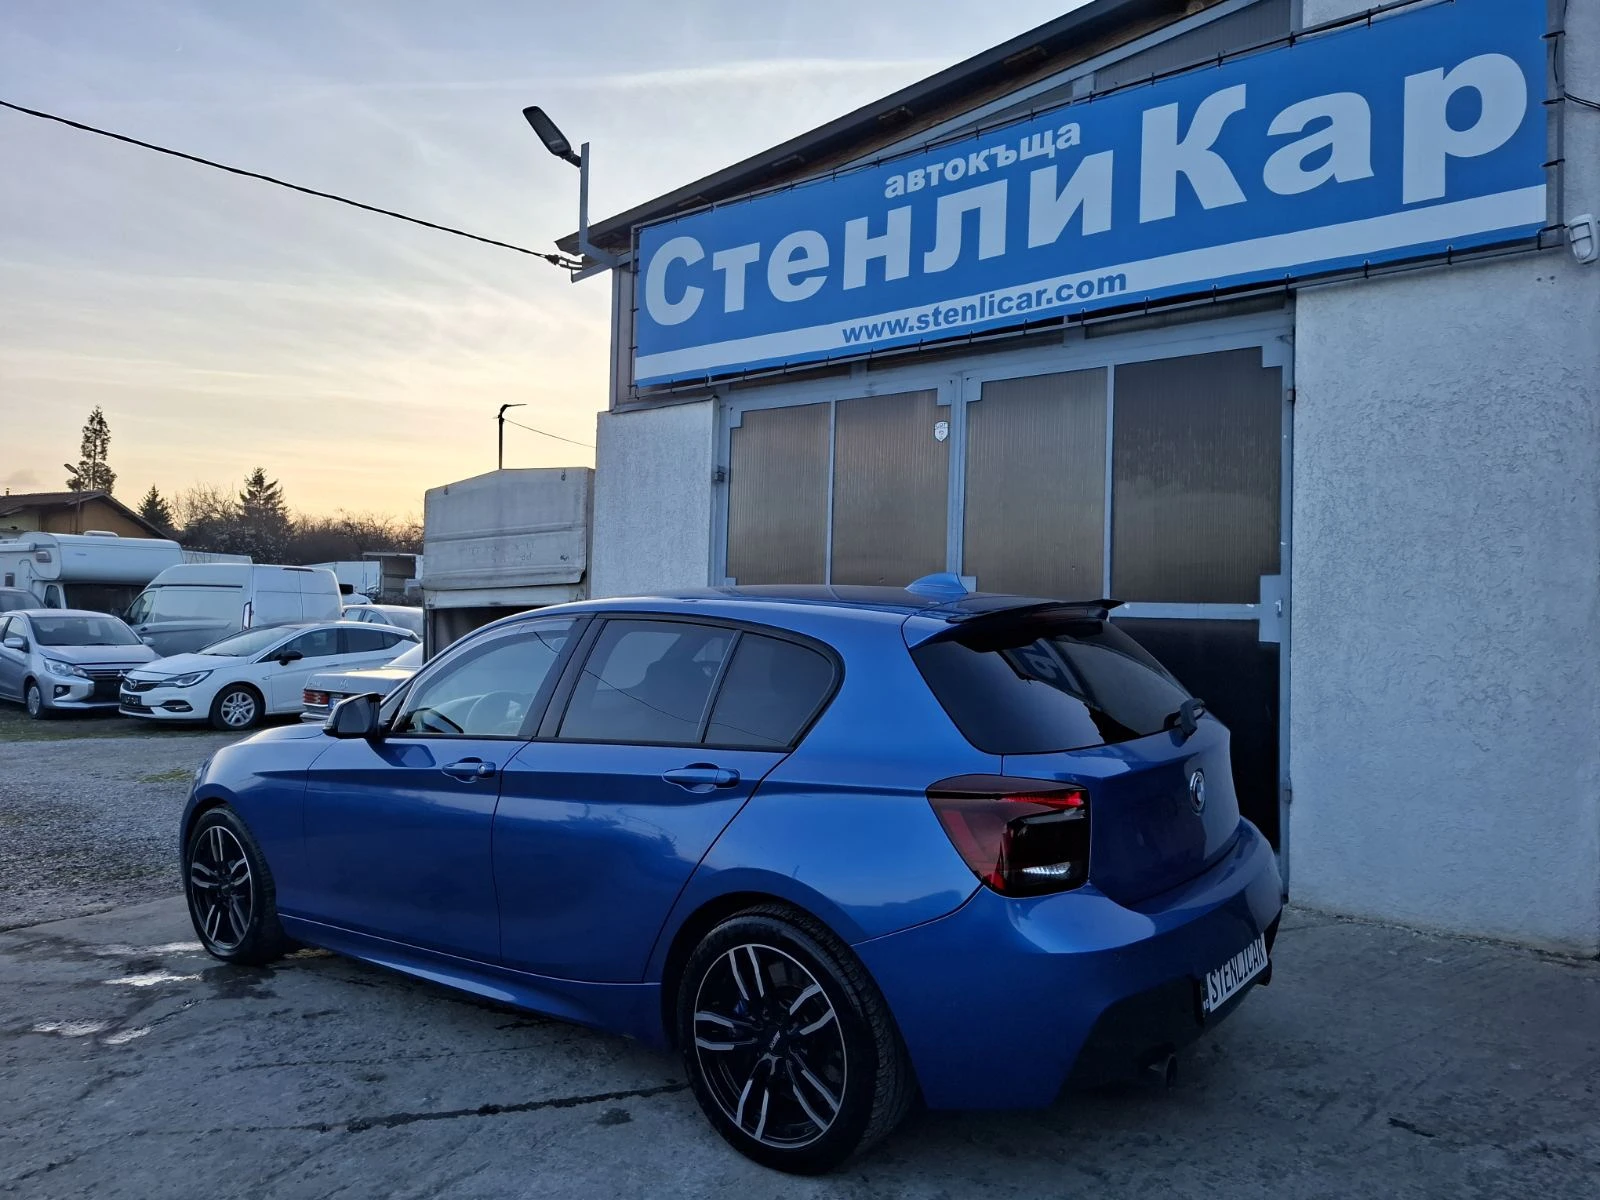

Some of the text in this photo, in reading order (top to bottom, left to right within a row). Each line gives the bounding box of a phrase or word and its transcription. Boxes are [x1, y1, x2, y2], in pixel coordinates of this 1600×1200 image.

[645, 53, 1528, 326] СтенлиКар
[884, 122, 1081, 199] автокъща
[842, 272, 1127, 344] www.stenlicar.com
[1209, 938, 1266, 1003] STENLICAR
